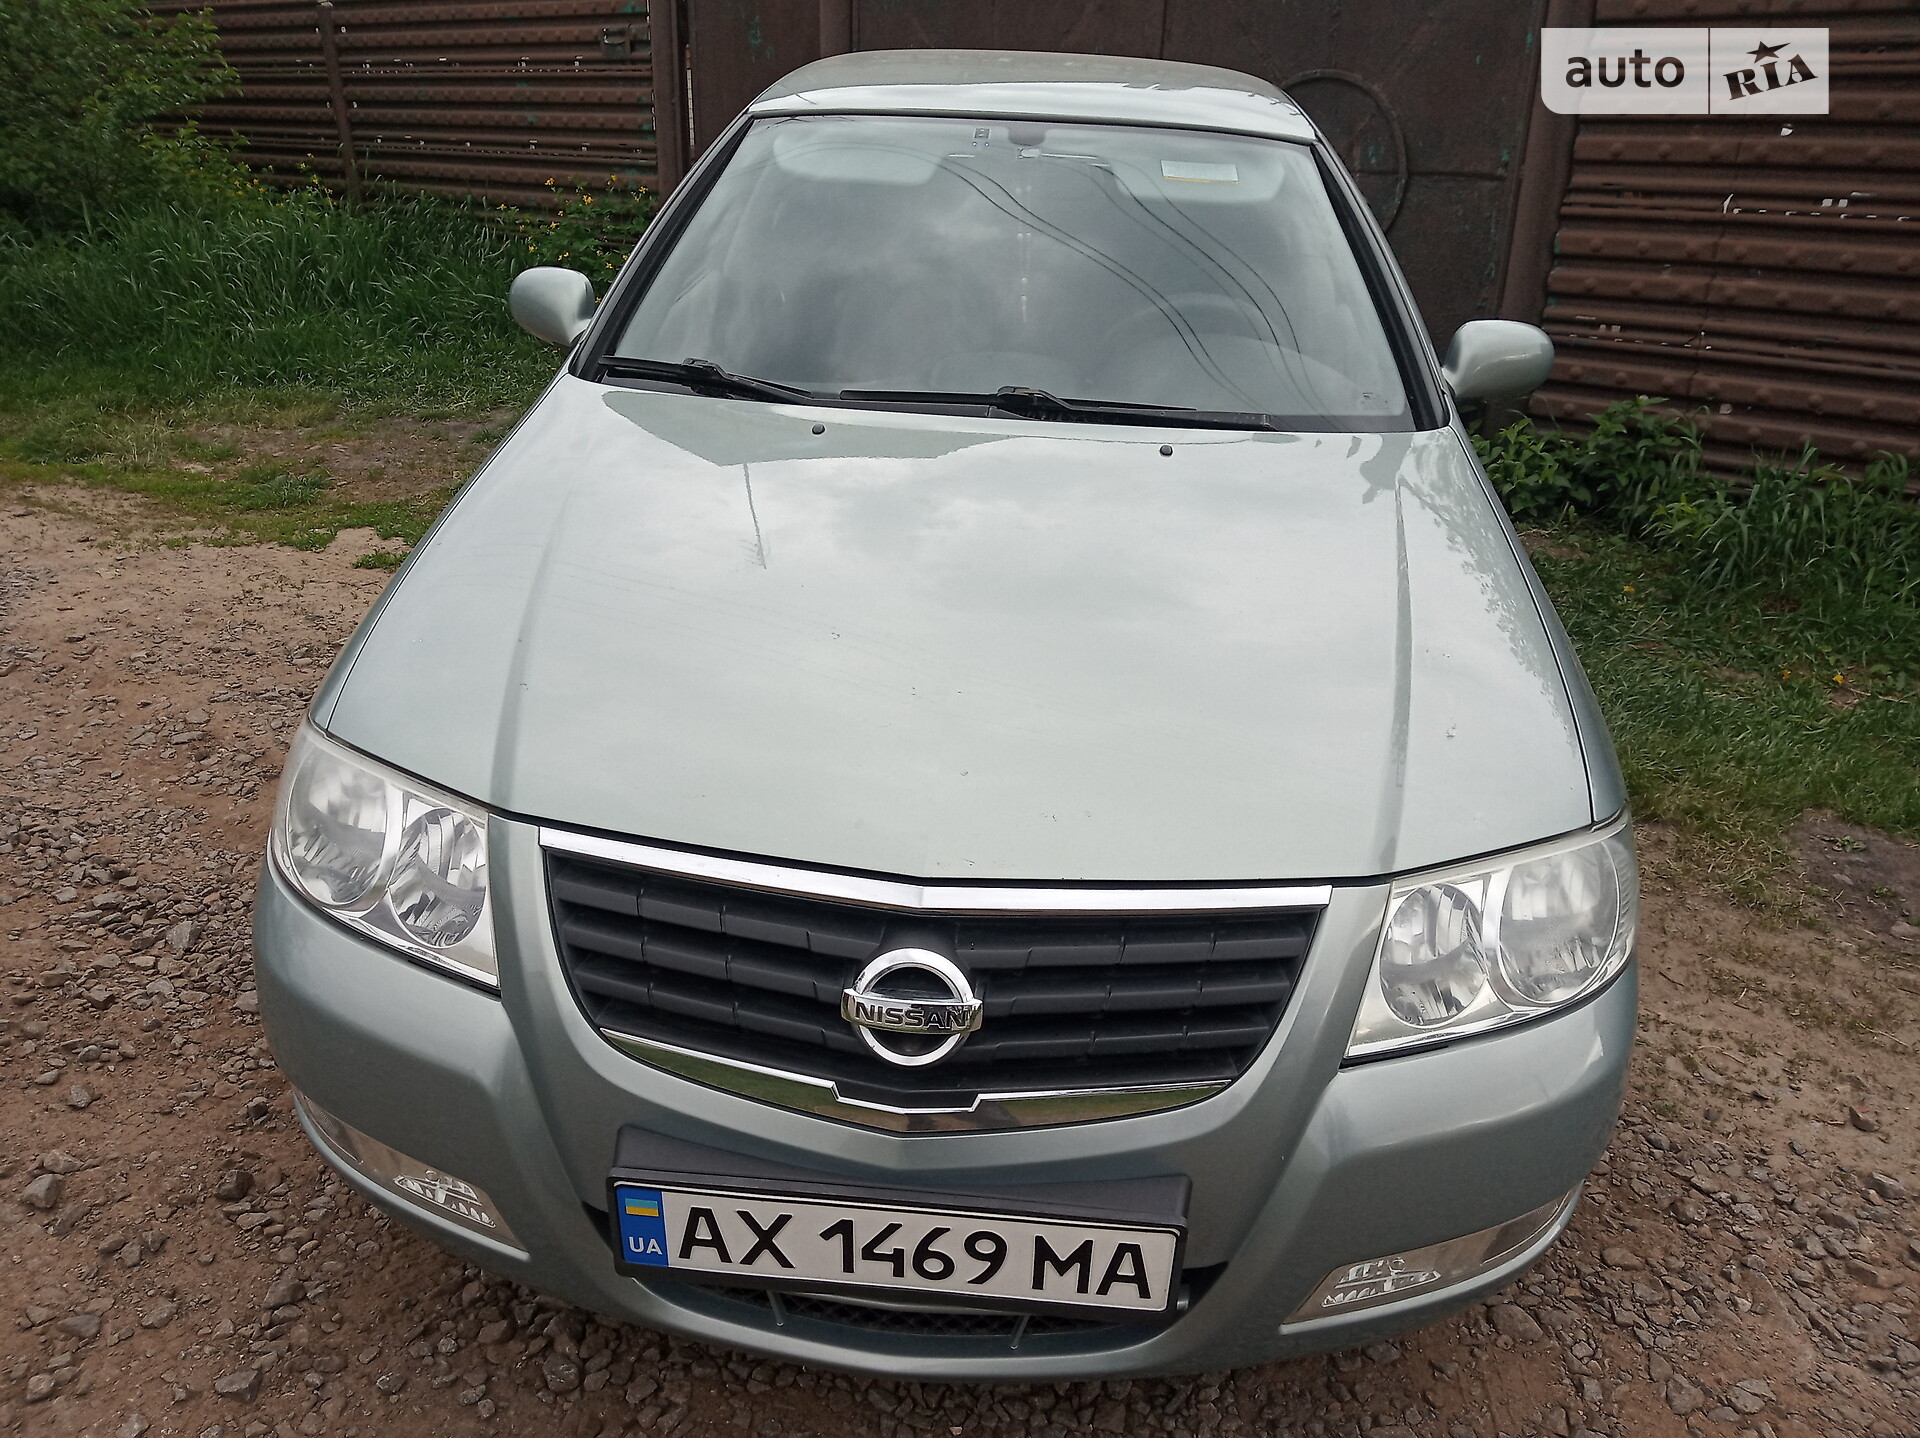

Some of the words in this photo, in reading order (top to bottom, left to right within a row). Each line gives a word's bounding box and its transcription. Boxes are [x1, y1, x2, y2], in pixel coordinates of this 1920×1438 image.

[855, 1002, 969, 1029] NISSAN
[628, 1235, 663, 1256] UA
[678, 1206, 796, 1269] AX
[818, 1217, 1008, 1285] 1469
[1030, 1234, 1152, 1299] MA
